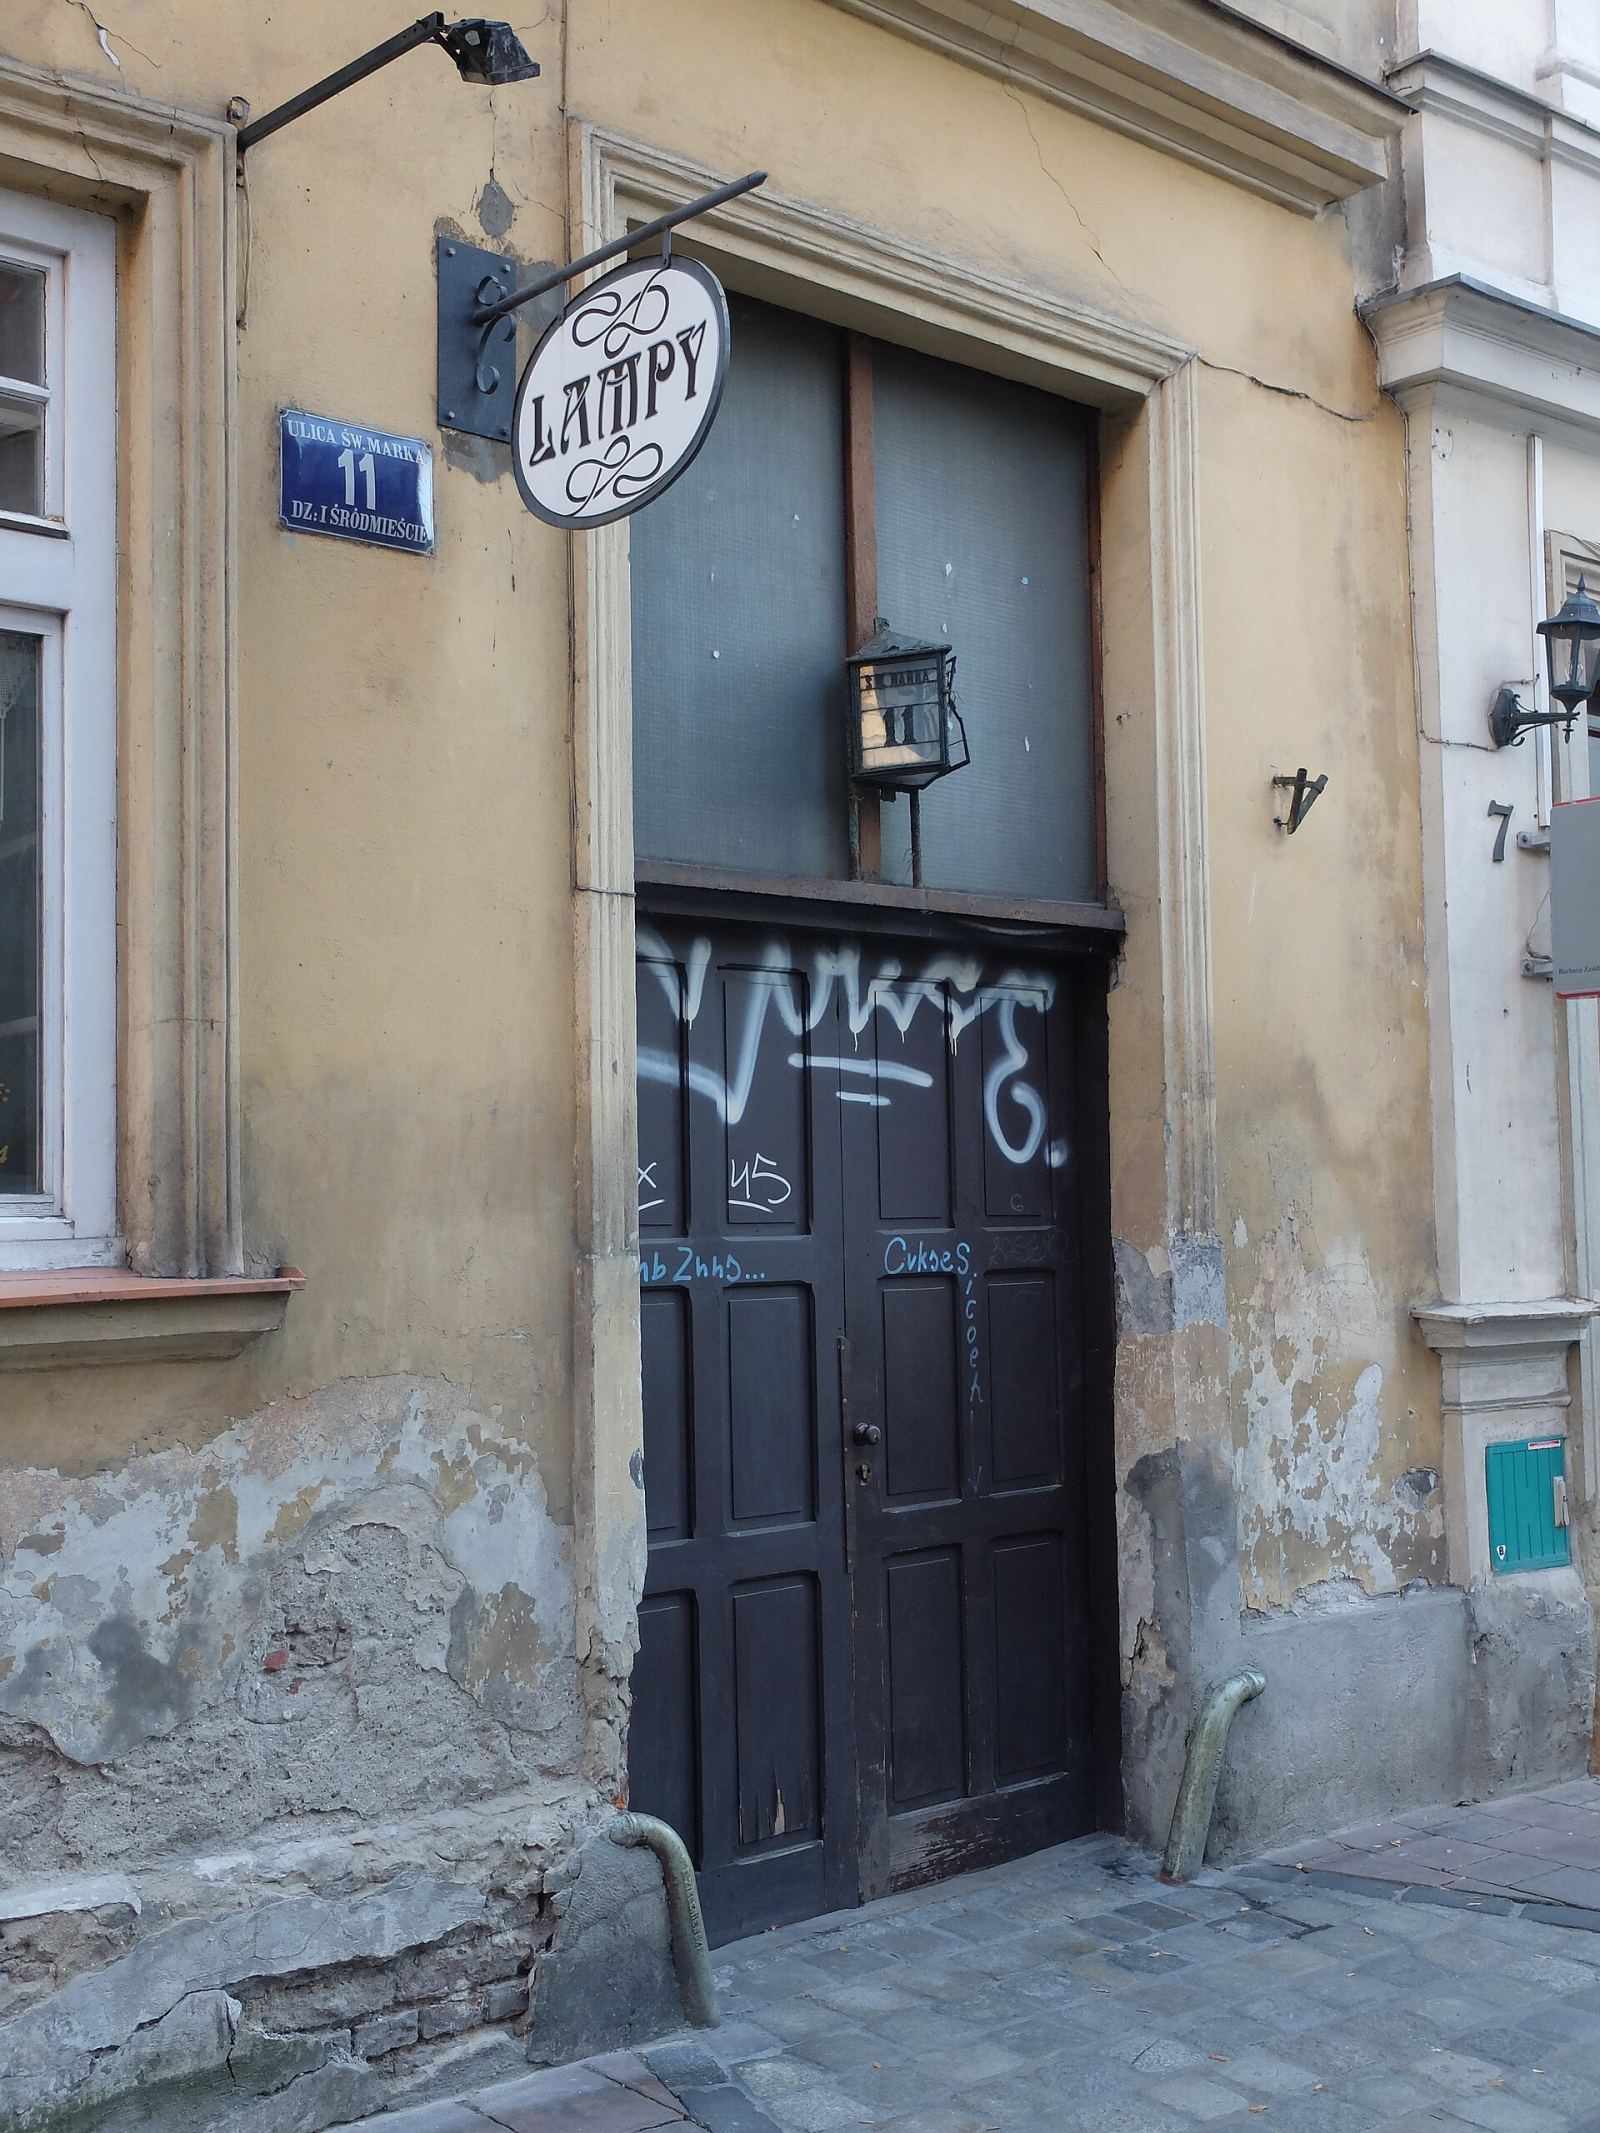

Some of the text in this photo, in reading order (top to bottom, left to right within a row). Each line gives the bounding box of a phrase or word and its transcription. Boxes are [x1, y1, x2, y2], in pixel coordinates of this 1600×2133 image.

[530, 319, 706, 466] LAMPY
[287, 419, 425, 465] ULICA ŚW. MARKA
[337, 448, 376, 510] 11
[320, 505, 328, 524] I
[330, 503, 428, 544] ŚRÓDMIEŚCIE
[883, 704, 917, 747] 11
[1487, 799, 1514, 862] 7
